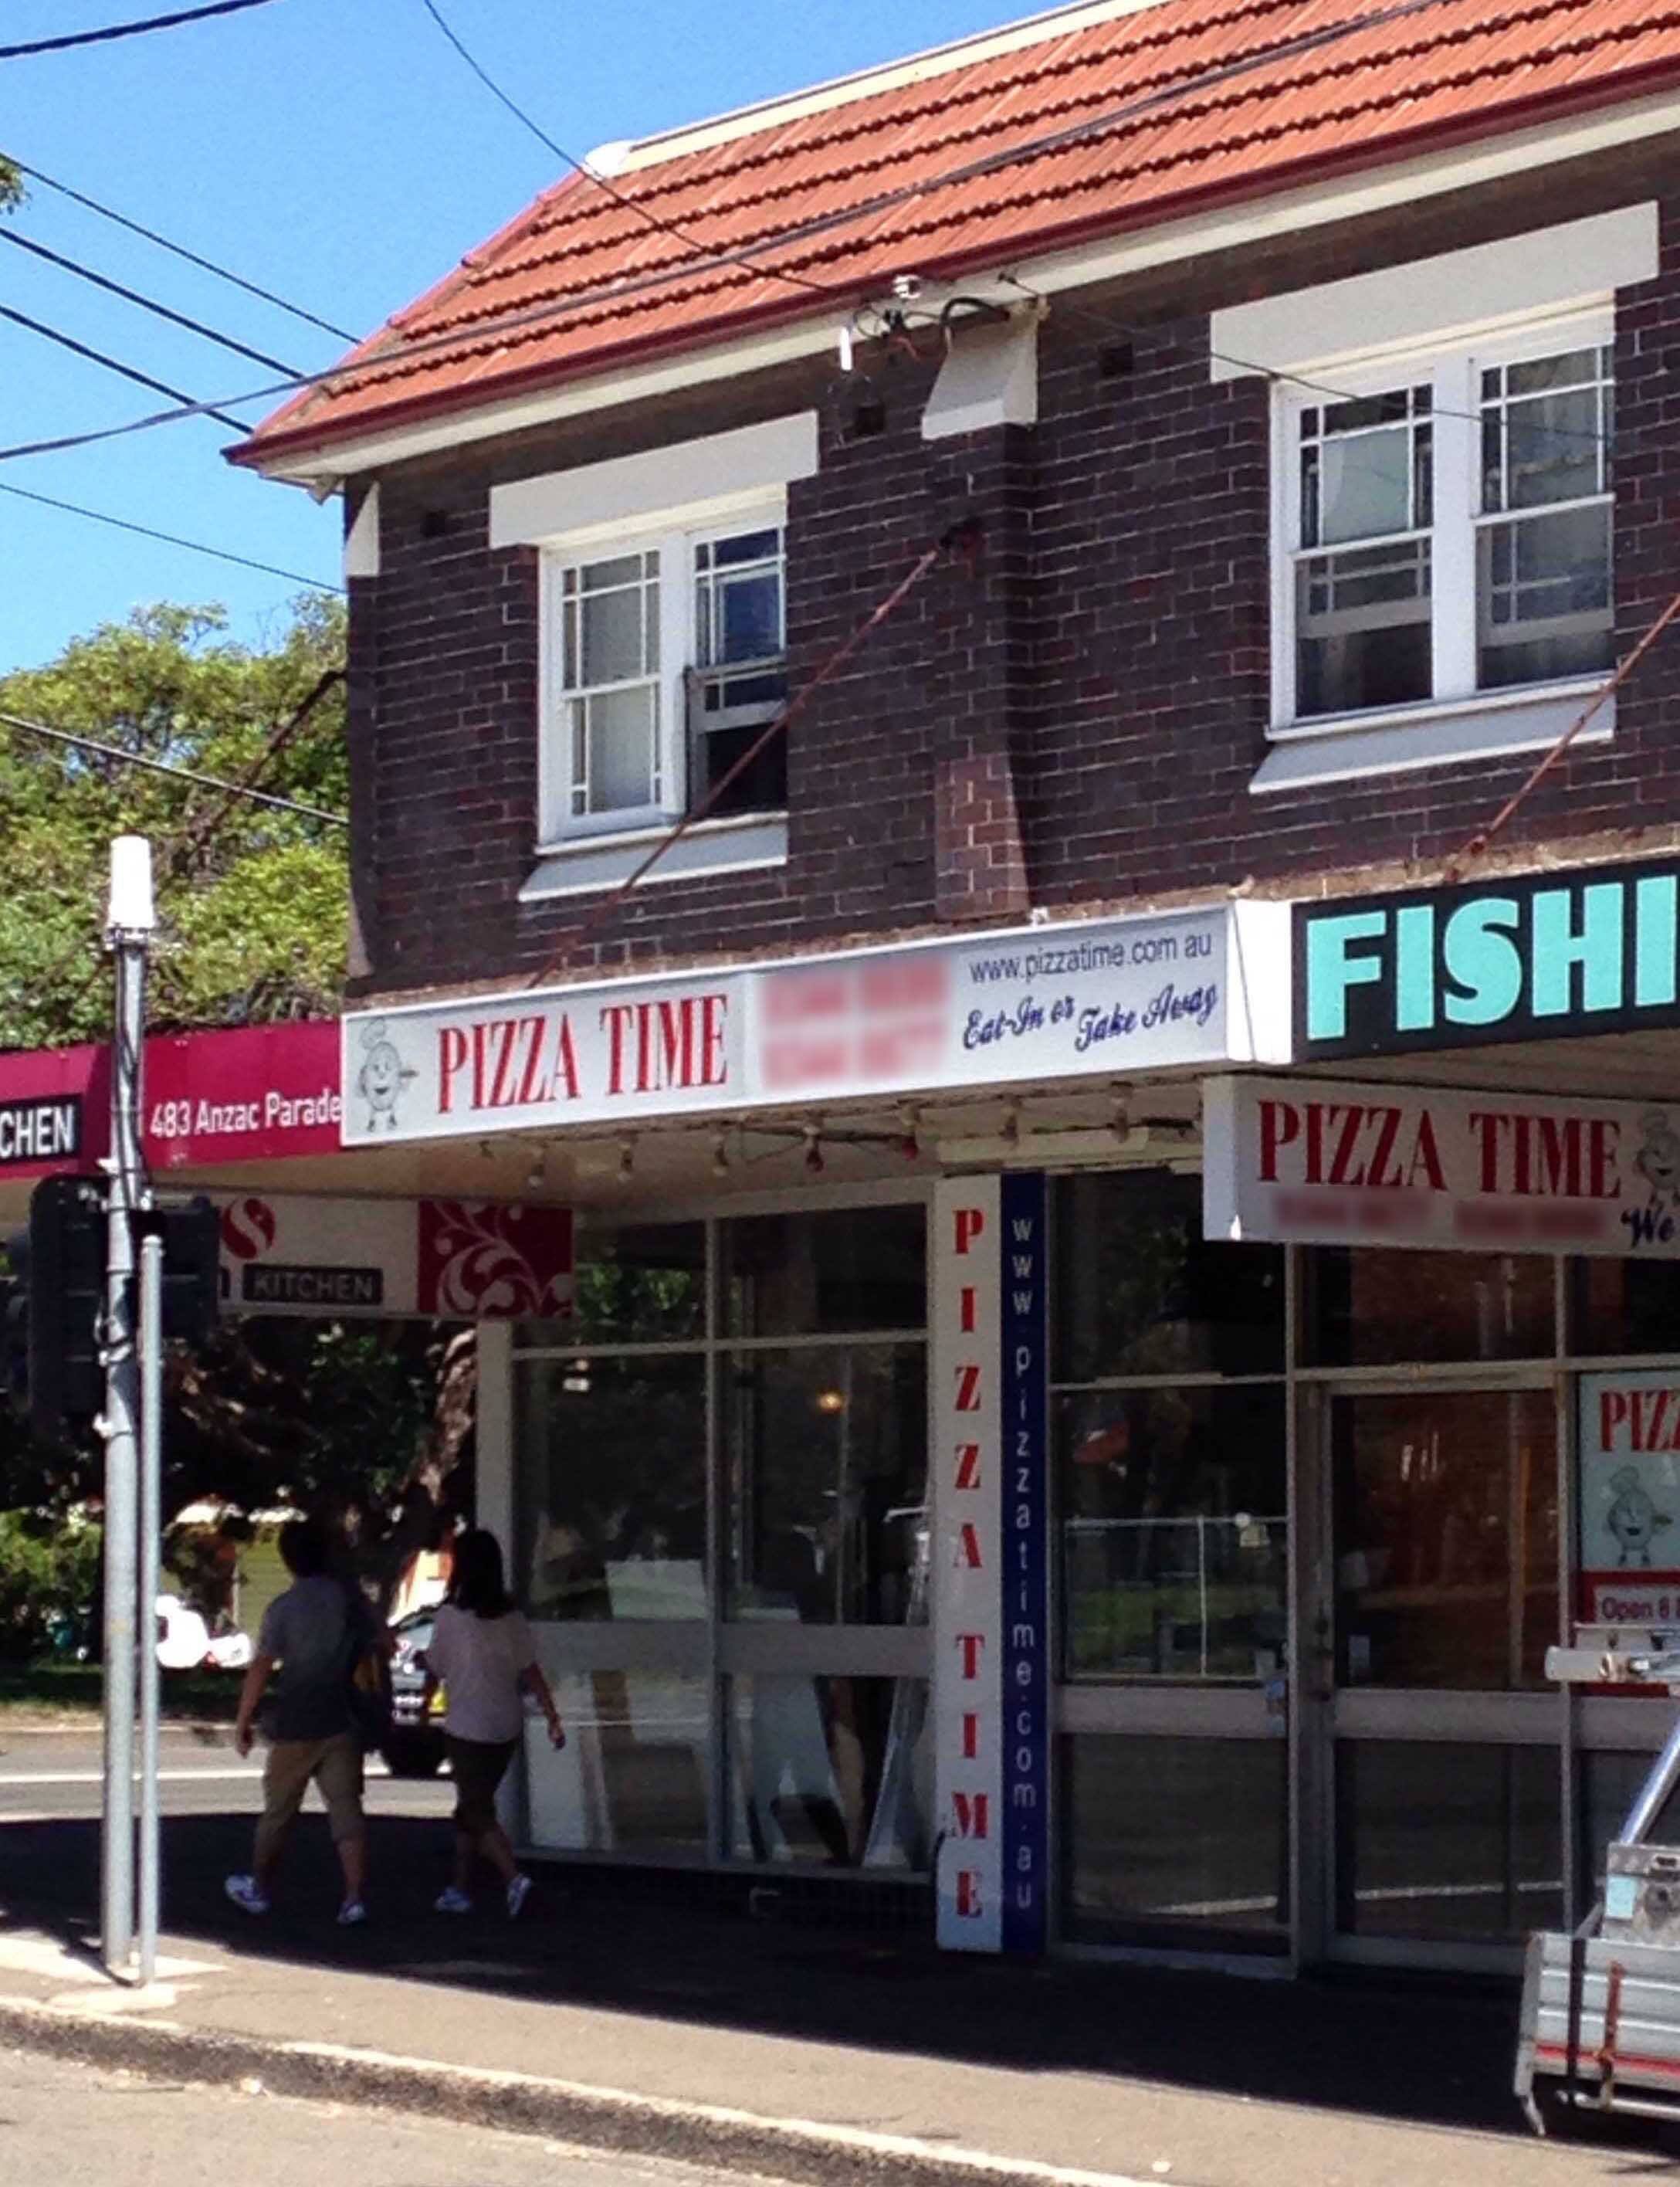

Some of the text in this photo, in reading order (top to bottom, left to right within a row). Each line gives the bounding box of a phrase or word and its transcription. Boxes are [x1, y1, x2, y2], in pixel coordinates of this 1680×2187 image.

[1307, 875, 1678, 1040] FISHI
[964, 995, 1044, 1049] Eat-In
[1075, 1003, 1137, 1051] Take
[1142, 983, 1218, 1027] Away
[438, 1013, 581, 1114] PIZZA
[599, 994, 728, 1096] TIME
[0, 1104, 74, 1158] CHEN
[150, 1087, 342, 1138] 483 Anzac Parade
[1257, 1099, 1621, 1199] PIZZA TIME
[253, 1273, 374, 1300] KITCHEN
[950, 1209, 989, 1918] PIZZA TIME
[1602, 1596, 1654, 1622] Open
